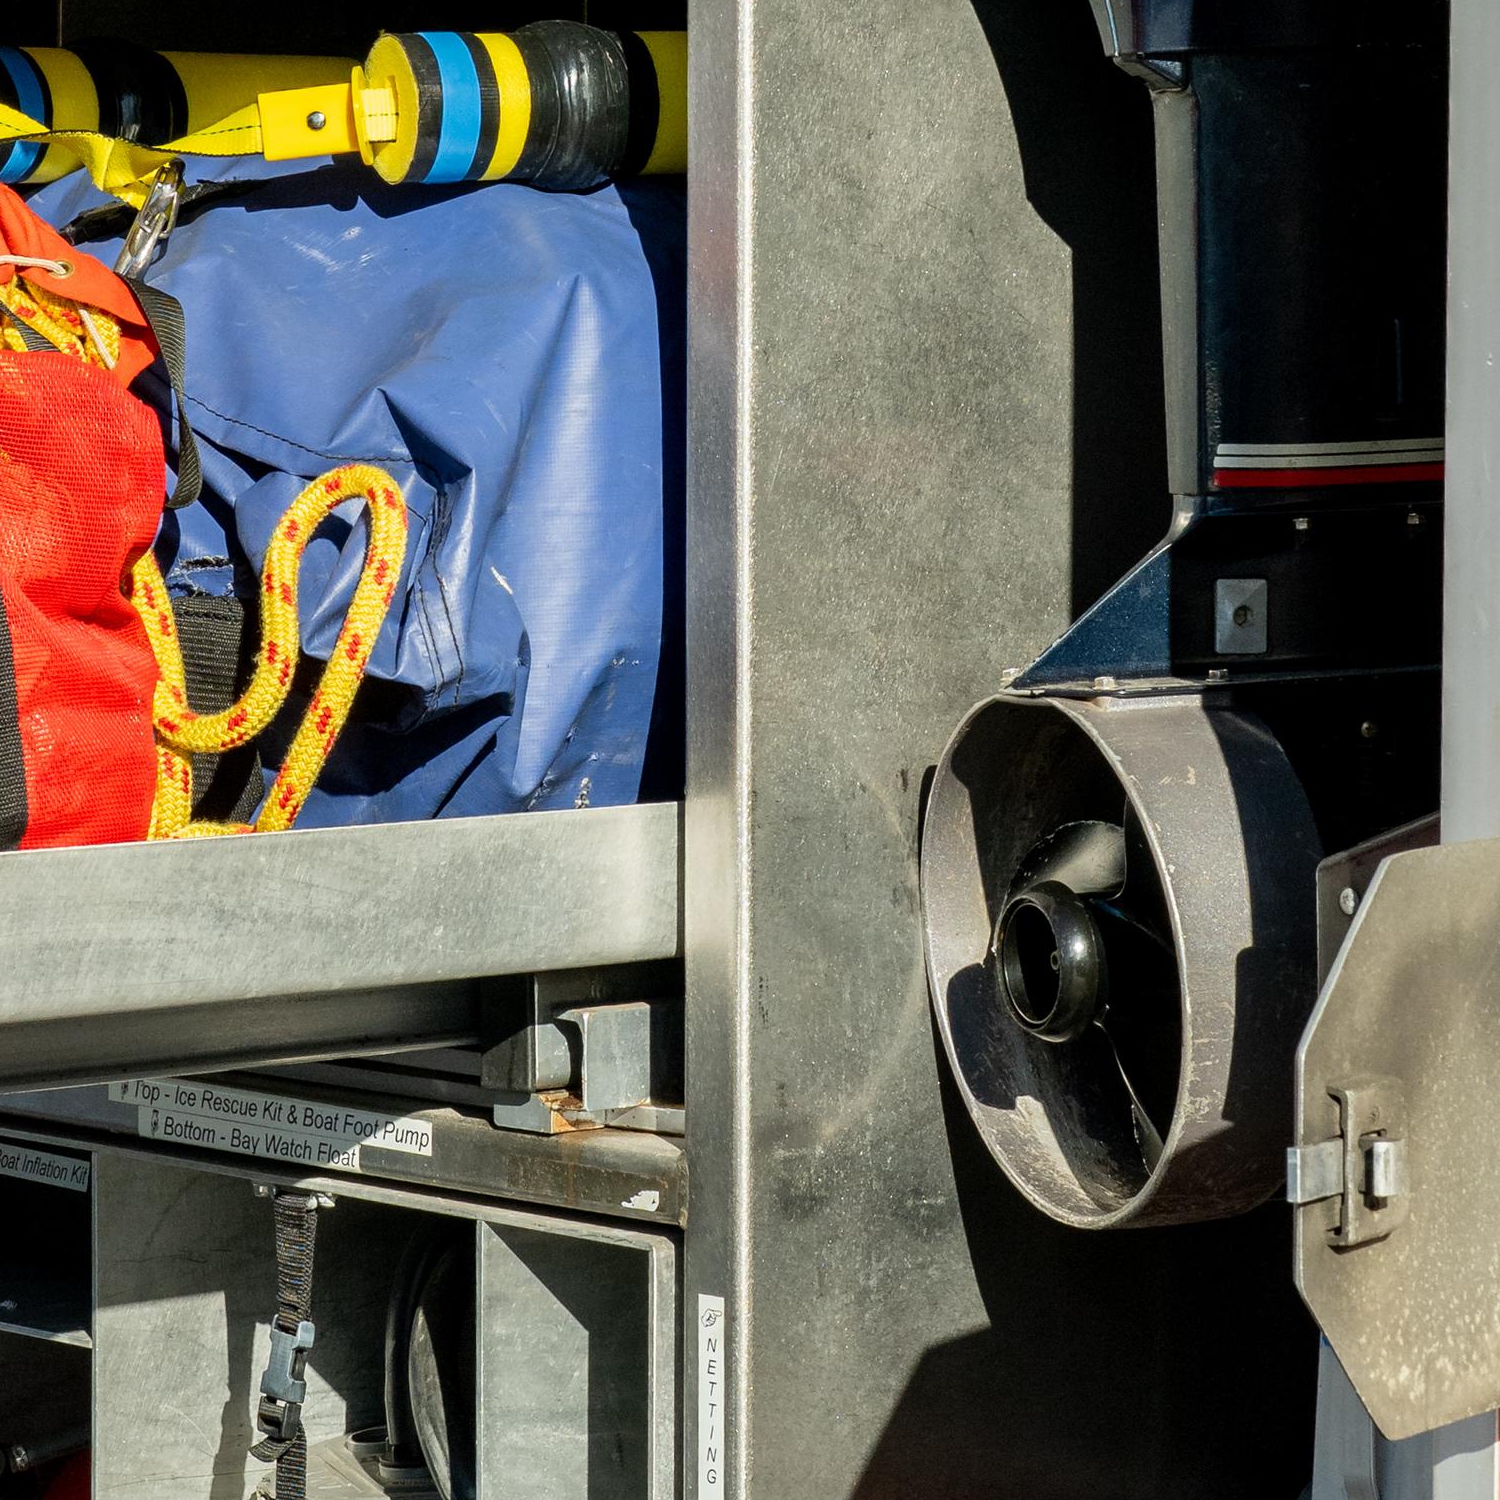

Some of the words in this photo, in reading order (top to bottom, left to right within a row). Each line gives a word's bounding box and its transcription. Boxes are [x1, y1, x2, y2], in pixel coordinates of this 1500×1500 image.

[134, 1080, 160, 1105] Top
[174, 1086, 197, 1107] Ice
[201, 1090, 258, 1117] Rescue
[262, 1100, 283, 1122] Kit
[287, 1104, 298, 1125] &
[302, 1107, 339, 1133] Boat
[343, 1114, 379, 1139] Foot
[383, 1121, 429, 1151] Pump
[164, 1116, 216, 1144] Bottom
[230, 1128, 260, 1155] Bay
[265, 1133, 312, 1160] Watch
[317, 1142, 357, 1168] Float
[21, 1154, 68, 1181] Inflation
[70, 1165, 88, 1185] Kit
[706, 1337, 717, 1484] NETTING
